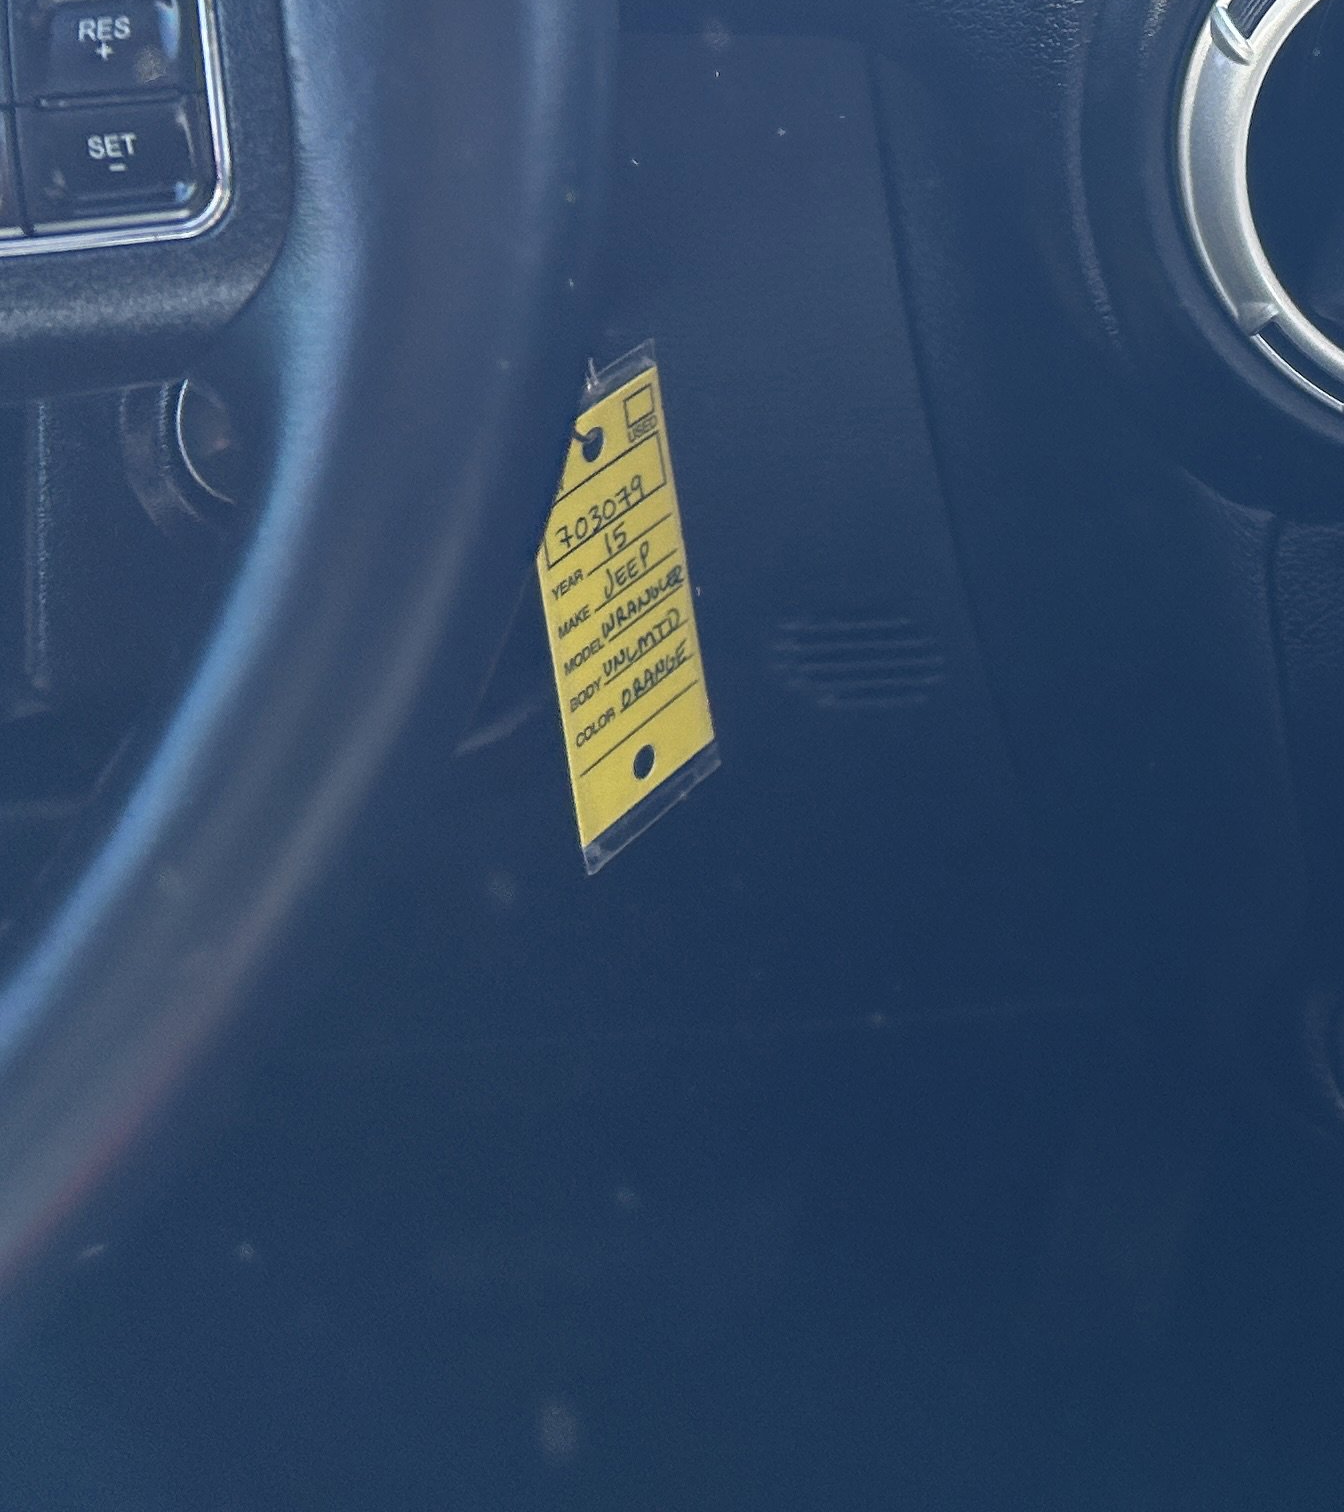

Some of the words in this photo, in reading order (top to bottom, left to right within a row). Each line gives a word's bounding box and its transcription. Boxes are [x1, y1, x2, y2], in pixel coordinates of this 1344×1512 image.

[78, 15, 132, 41] RES
[87, 132, 137, 160] SET
[556, 474, 647, 549] 703079
[605, 521, 628, 556] 15
[552, 568, 584, 600] YEAR
[604, 540, 650, 599] JEEP
[558, 604, 591, 639] MAKE
[563, 638, 605, 676] MODEL
[620, 638, 688, 710] ORANGE
[570, 676, 602, 713] BODY
[576, 706, 616, 748] COLOR
